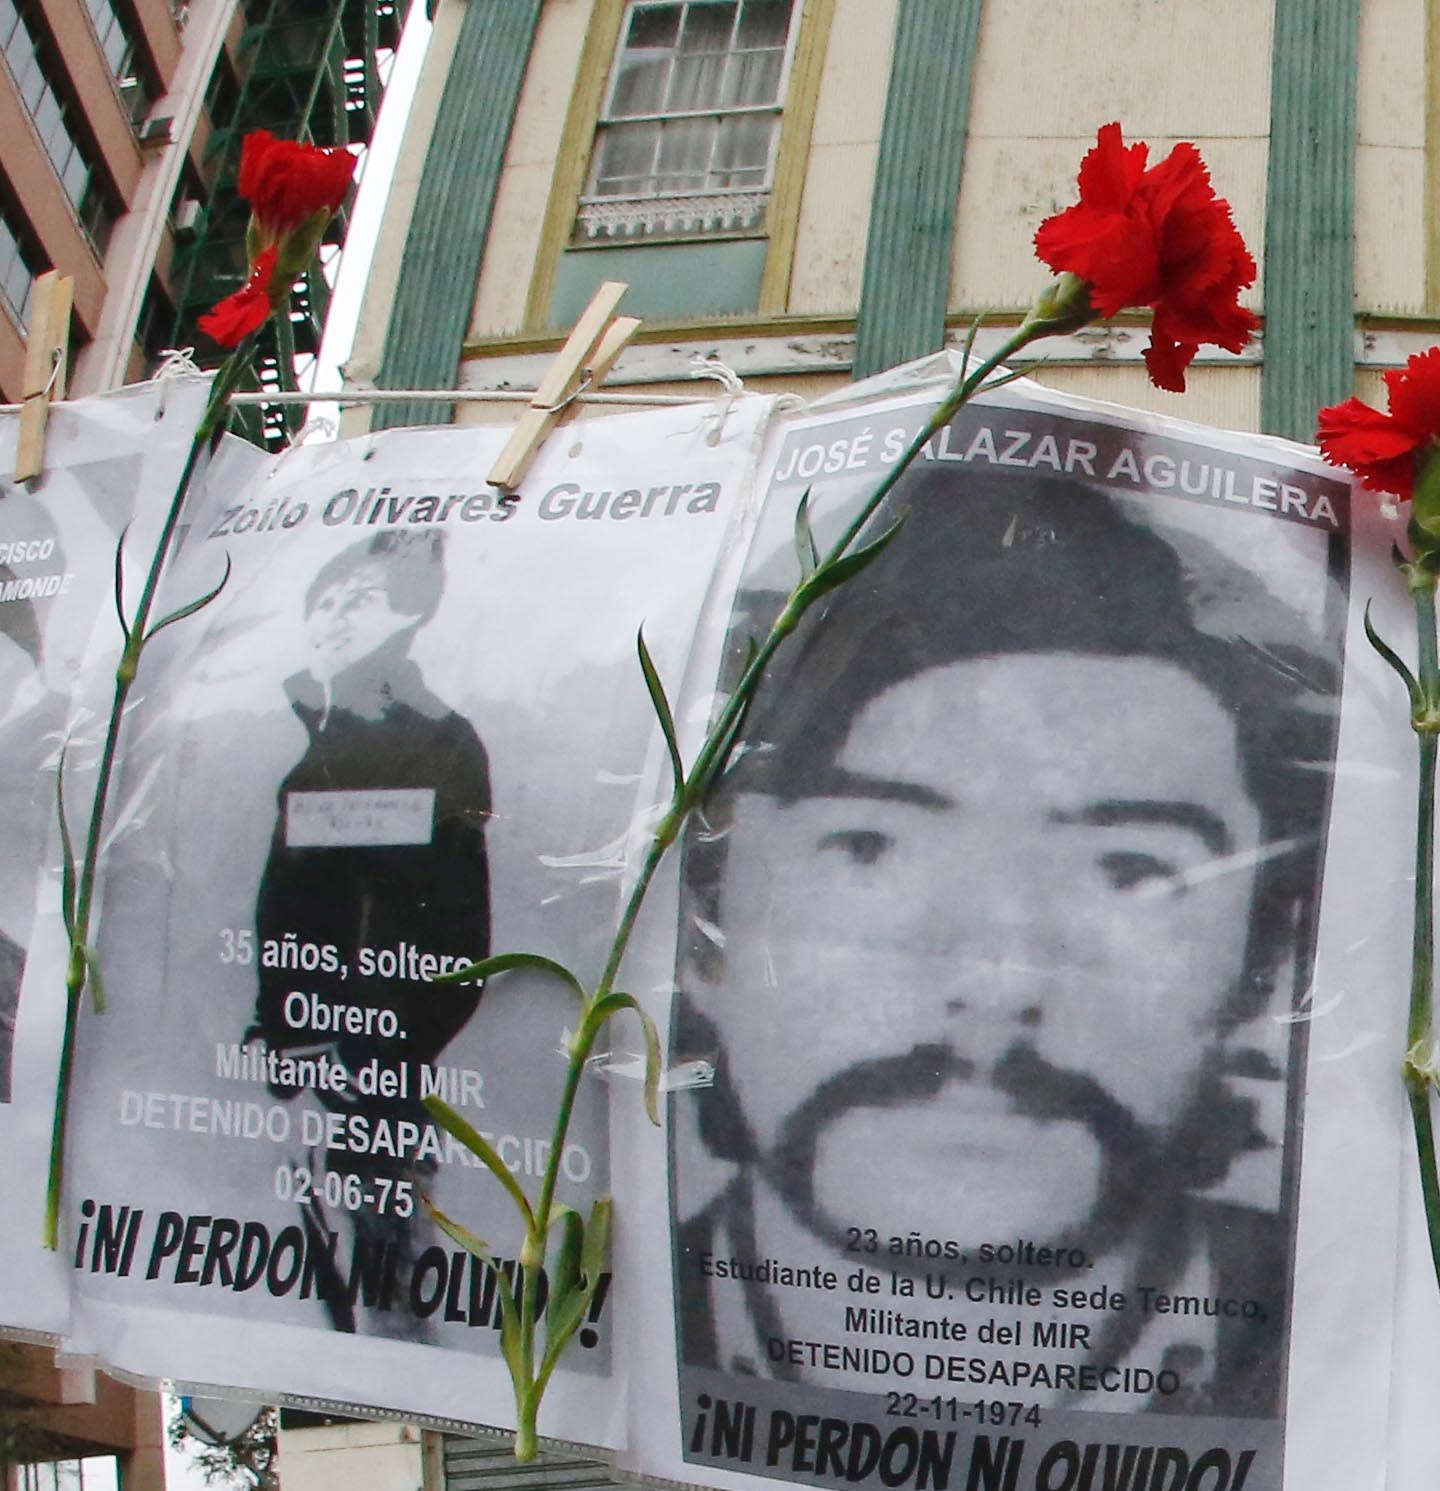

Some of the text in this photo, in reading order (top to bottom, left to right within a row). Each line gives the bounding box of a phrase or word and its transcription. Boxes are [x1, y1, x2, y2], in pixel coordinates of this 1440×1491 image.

[776, 426, 872, 483] JOSÉ
[1107, 448, 1339, 528] AGUILERA
[208, 481, 722, 540] Zoilo Olivares Guerra
[218, 928, 486, 988] 35 años, soltero.
[284, 990, 407, 1040] Obrero.
[215, 1042, 485, 1110] Militante del MIR
[119, 1089, 291, 1145] DETENIDO
[274, 1165, 415, 1219] 02-06-75
[75, 1198, 144, 1278] ¡NI
[146, 1211, 339, 1301] PERDON
[846, 1226, 1095, 1270] 23 años, soltero.
[701, 1253, 838, 1293] Estudiante
[847, 1266, 882, 1295] de
[890, 1269, 915, 1298] la
[925, 1271, 955, 1301] U.
[965, 1277, 1043, 1308] Chile
[1052, 1281, 1126, 1312] sede
[844, 1306, 1091, 1351] Militante del MIR
[767, 1337, 1182, 1397] DETENIDO DESAPARECIDO
[690, 1395, 756, 1465] ¡NI
[885, 1391, 1043, 1430] 22-11-1974
